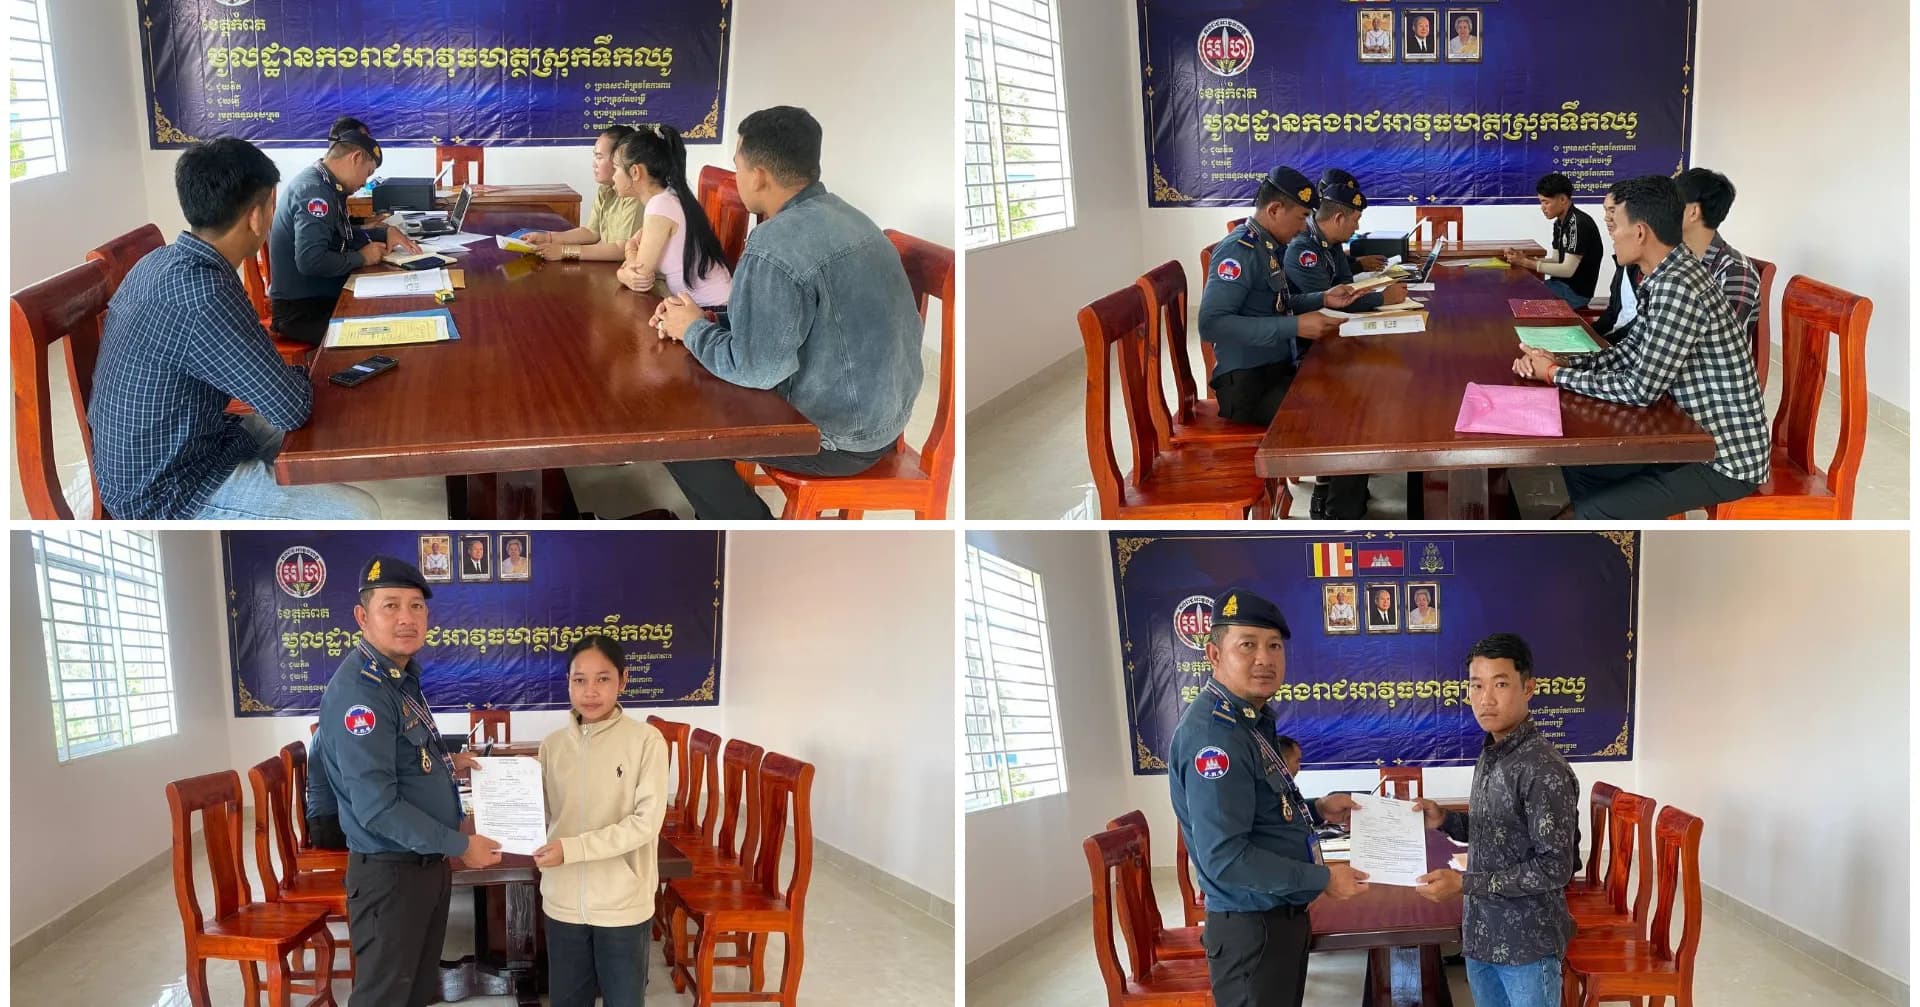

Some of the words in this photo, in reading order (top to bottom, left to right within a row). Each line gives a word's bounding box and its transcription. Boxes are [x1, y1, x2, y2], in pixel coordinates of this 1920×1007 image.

[202, 12, 266, 36] ខេត្តកំពត
[207, 34, 673, 78] មូលដ្ឋានកងរាជអាវុធហត្ថស្រុកទឹកឈូ
[1199, 82, 1257, 105] ខេត្តកំពត
[1202, 100, 1638, 142] មូលដ្ឋានកងរាជអាវុធហត្ថស្រុកទឹកឈូ
[277, 603, 330, 624] ខេត្តកំពត
